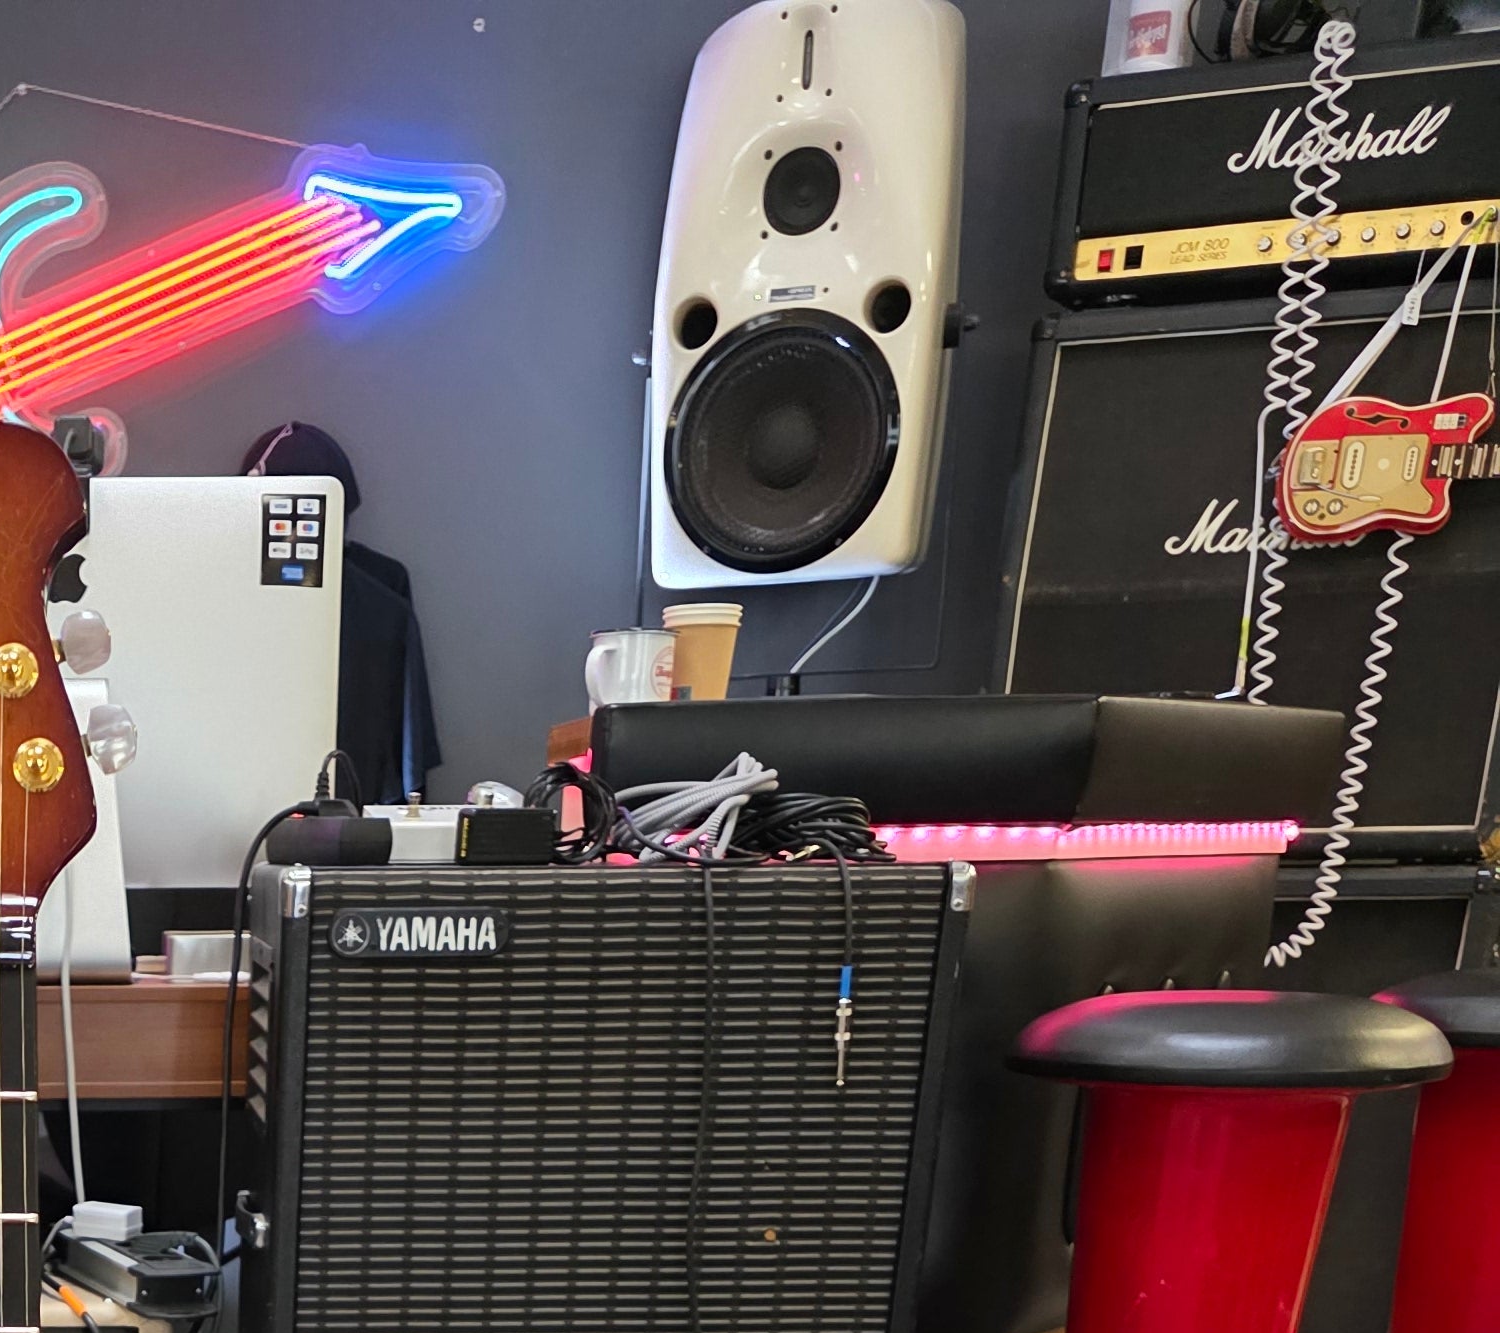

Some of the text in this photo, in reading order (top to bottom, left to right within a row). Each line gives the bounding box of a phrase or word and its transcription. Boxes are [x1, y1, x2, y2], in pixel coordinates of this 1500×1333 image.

[1227, 105, 1451, 174] Marshall
[1169, 254, 1194, 265] LEAD
[1170, 238, 1230, 255] JCM 800
[376, 916, 497, 951] YAMAHA
